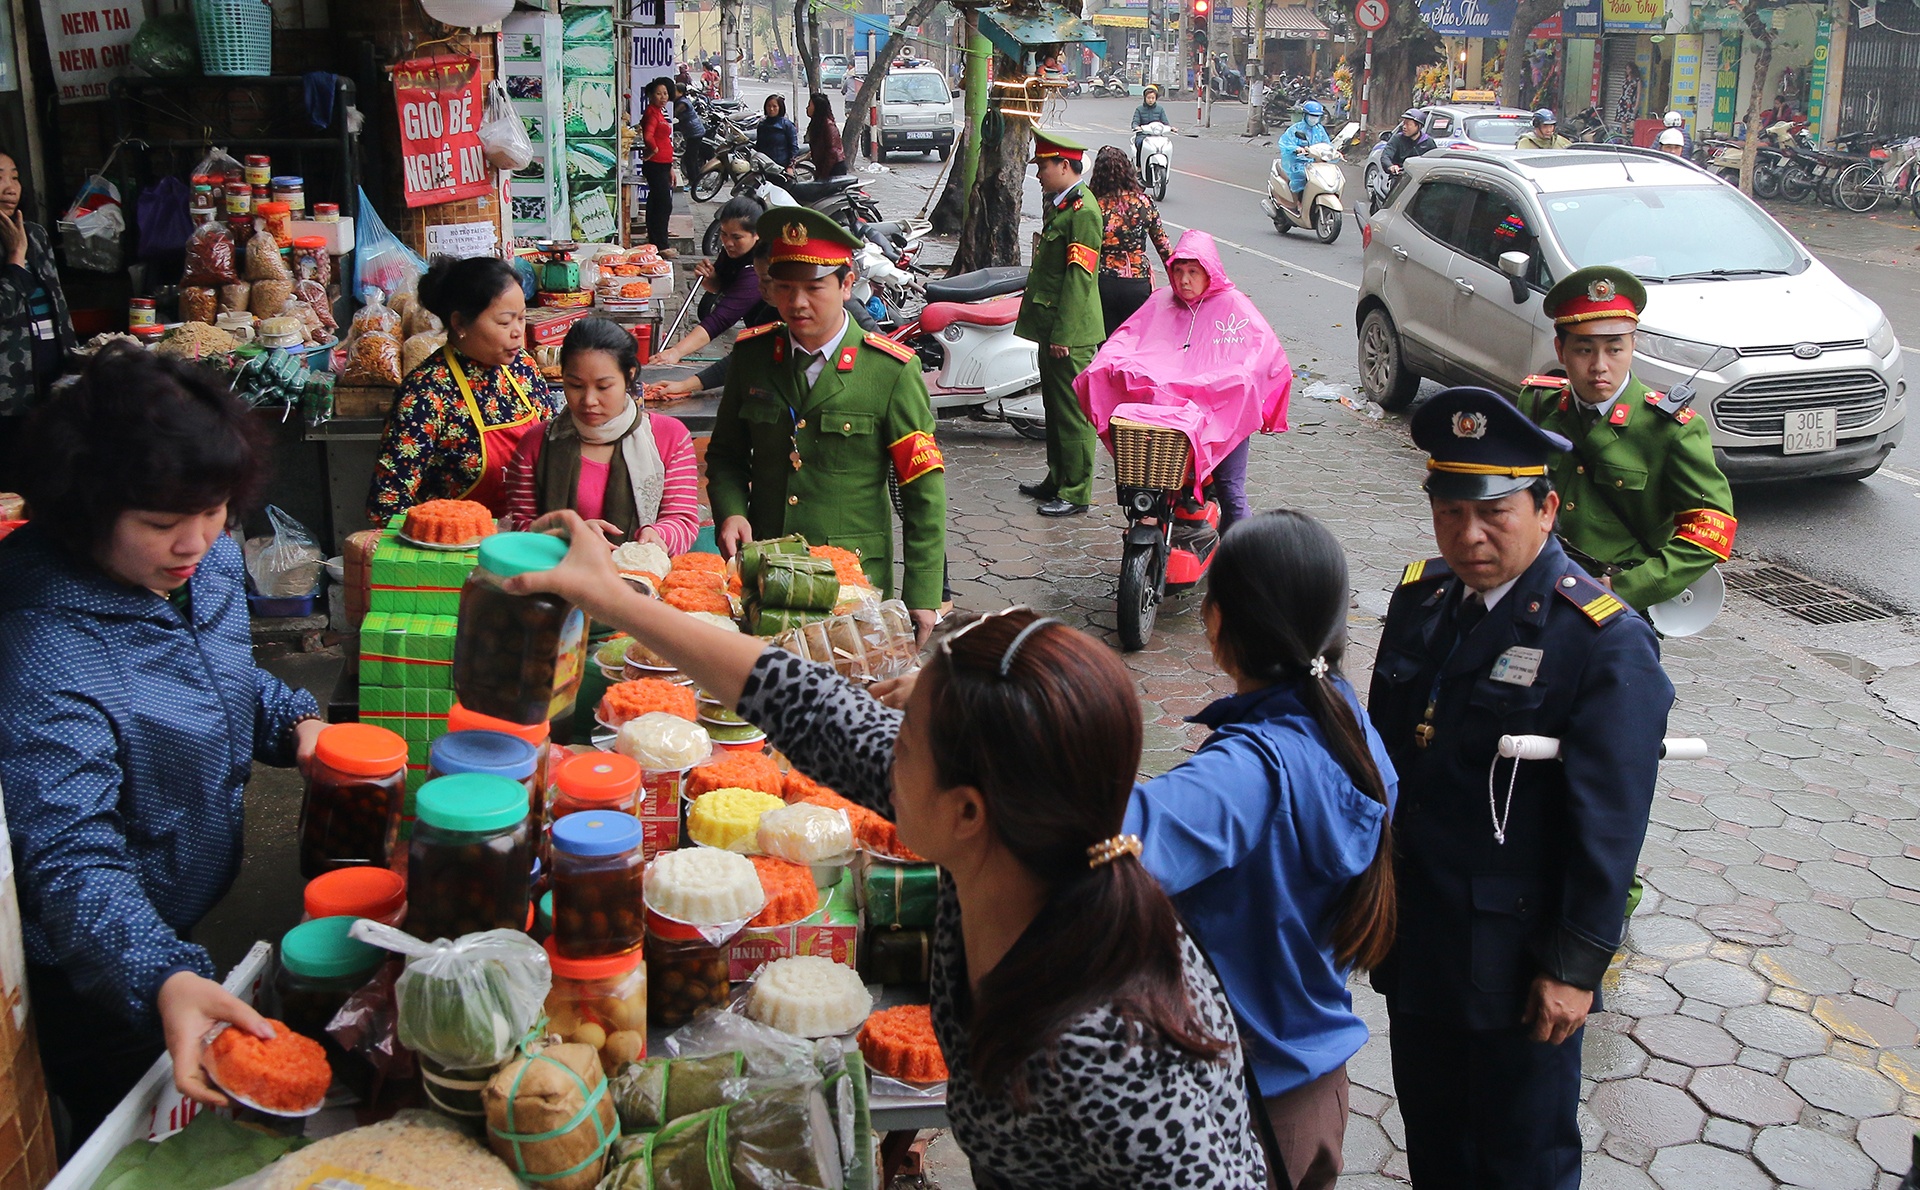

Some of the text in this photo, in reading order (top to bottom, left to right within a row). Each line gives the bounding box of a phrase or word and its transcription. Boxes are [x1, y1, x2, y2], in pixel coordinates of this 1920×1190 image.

[61, 8, 131, 35] NEM TAI
[1455, 0, 1490, 26] Màu
[633, 28, 672, 67] THUỐC
[1815, 48, 1826, 57] 67
[58, 48, 98, 72] NEM
[1718, 96, 1730, 113] BIA
[403, 89, 474, 141] GIÒ BÊ
[404, 142, 457, 195] NGHỆ
[459, 145, 486, 185] AN
[1212, 336, 1246, 345] WINNY
[1797, 411, 1825, 430] 30E
[1786, 430, 1833, 450] 024.51
[1712, 517, 1725, 531] TRA
[645, 822, 657, 838] AN
[820, 928, 833, 944] AN
[731, 946, 765, 960] NINH
